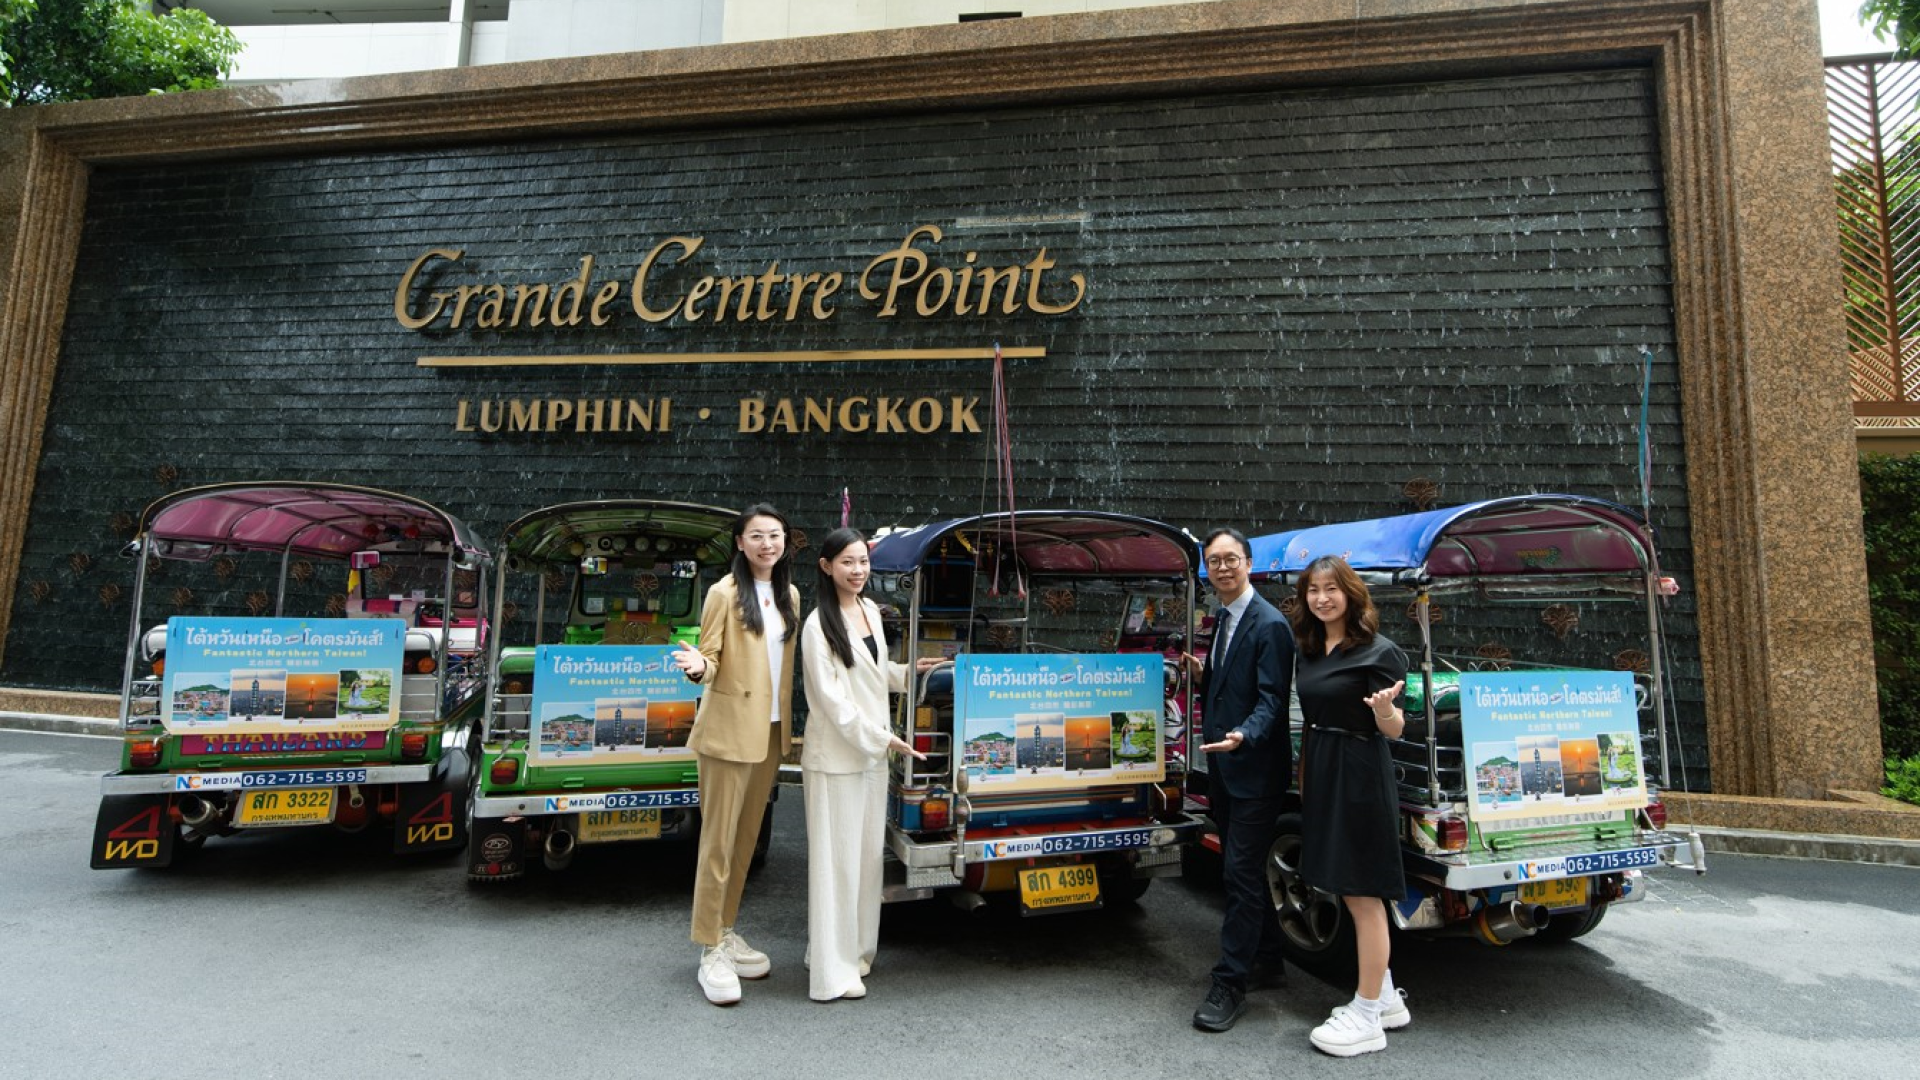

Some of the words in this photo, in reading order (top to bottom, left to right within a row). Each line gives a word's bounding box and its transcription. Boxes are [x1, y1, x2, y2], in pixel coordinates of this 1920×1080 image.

[394, 248, 618, 330] Grande
[632, 236, 842, 322] Centre
[859, 224, 1087, 318] Point
[455, 398, 672, 433] LUMPHINI
[738, 396, 982, 433] BANGKOK
[203, 648, 263, 657] Fantastic
[267, 648, 320, 657] Northern
[325, 648, 367, 657] Taiwan!
[569, 677, 625, 686] Fantastic
[629, 676, 678, 685] Northern
[989, 690, 1042, 699] Fantastic
[1045, 689, 1092, 698] Northern
[1096, 688, 1133, 697] Taiwan!
[203, 731, 367, 752] THAILAND
[177, 775, 201, 789] NC
[203, 777, 241, 786] MEDIA
[243, 770, 366, 787] 062-715-5595
[287, 791, 330, 809] 3322
[409, 792, 451, 824] 4
[546, 797, 569, 811] NC
[569, 798, 605, 807] MEDIA
[607, 793, 699, 807] 062-715-55
[108, 805, 161, 839] 4
[619, 809, 658, 825] 6829
[984, 841, 1007, 858] NC
[1007, 844, 1042, 853] MEDIA
[1043, 832, 1150, 853] 062-715-5595
[1518, 862, 1537, 880] NC
[1537, 863, 1567, 874] MEDIA
[1567, 849, 1656, 873] 062-715-5595
[1058, 867, 1095, 888] 4399
